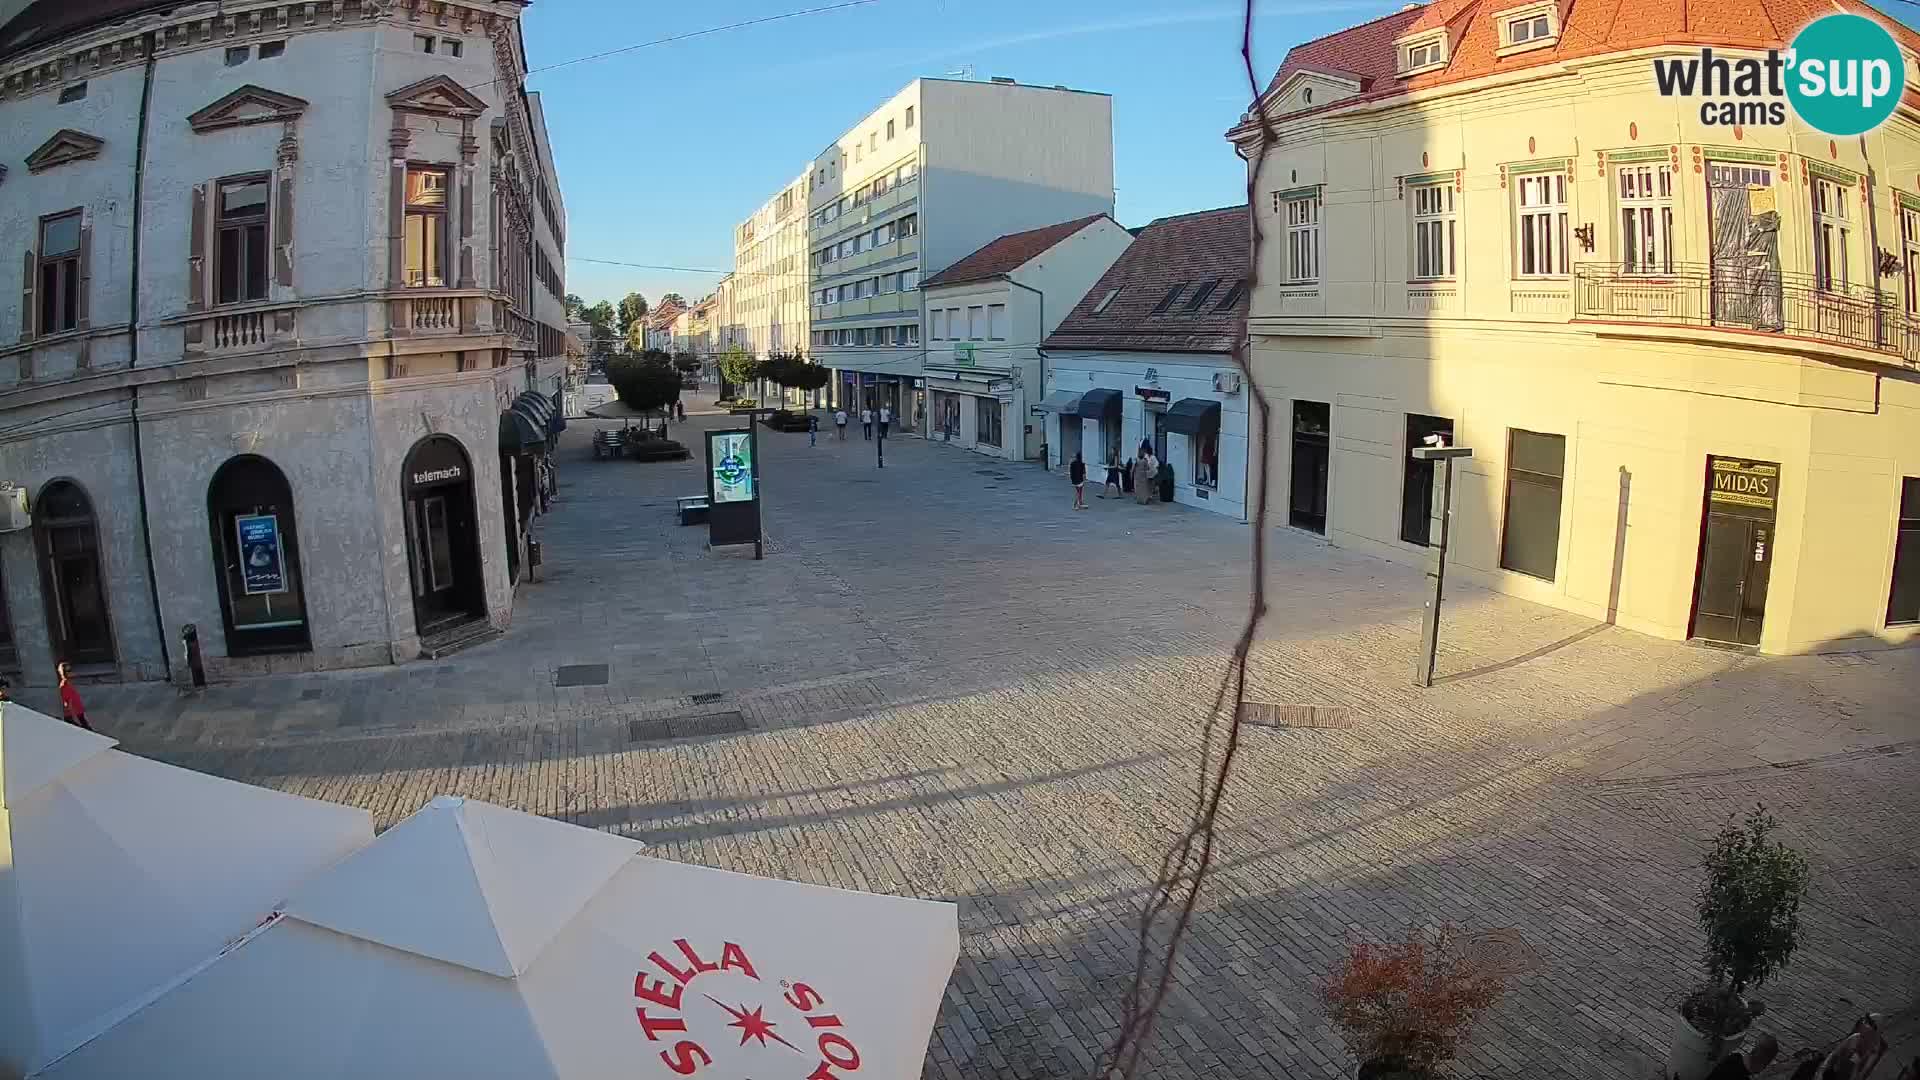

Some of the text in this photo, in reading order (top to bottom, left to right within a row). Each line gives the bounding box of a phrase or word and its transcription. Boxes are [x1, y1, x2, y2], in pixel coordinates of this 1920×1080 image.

[414, 465, 461, 483] telemach
[1714, 472, 1769, 495] MIDAS
[634, 938, 761, 1074] STELLA
